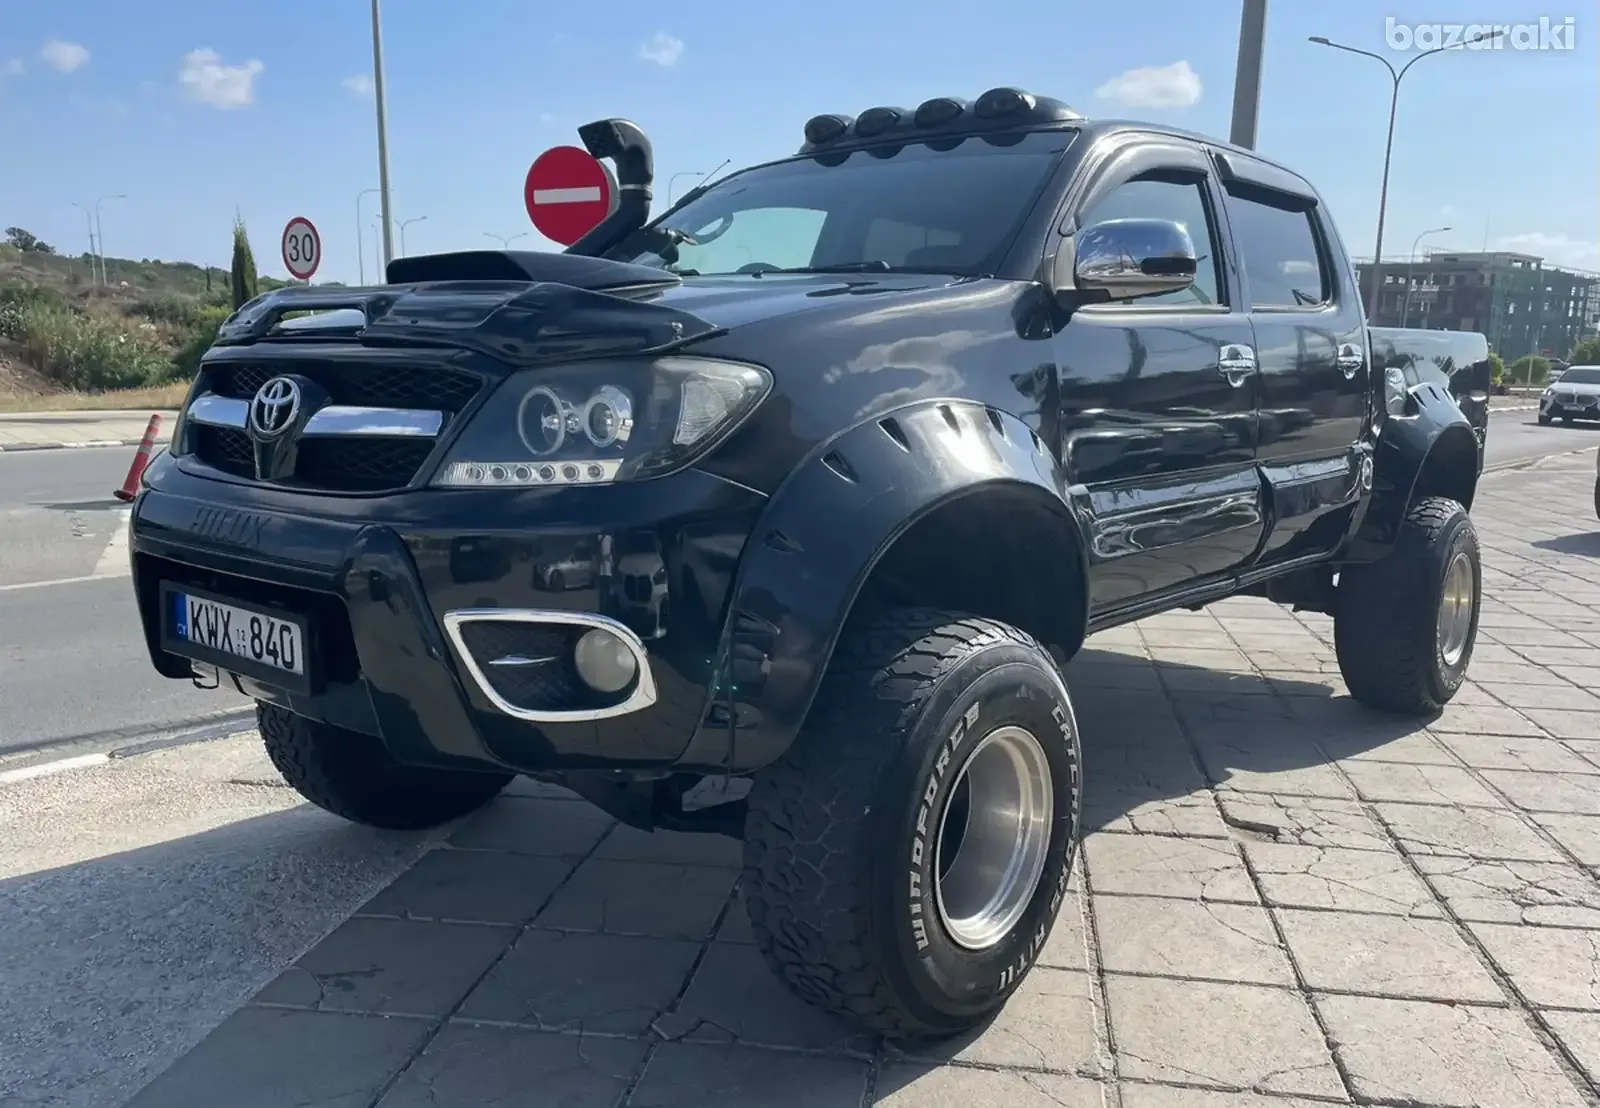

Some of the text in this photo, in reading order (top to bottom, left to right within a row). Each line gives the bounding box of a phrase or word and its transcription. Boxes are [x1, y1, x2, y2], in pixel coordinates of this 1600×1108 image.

[288, 233, 314, 262] 30
[190, 600, 295, 670] KWX 840
[909, 700, 980, 951] WINDFORCE
